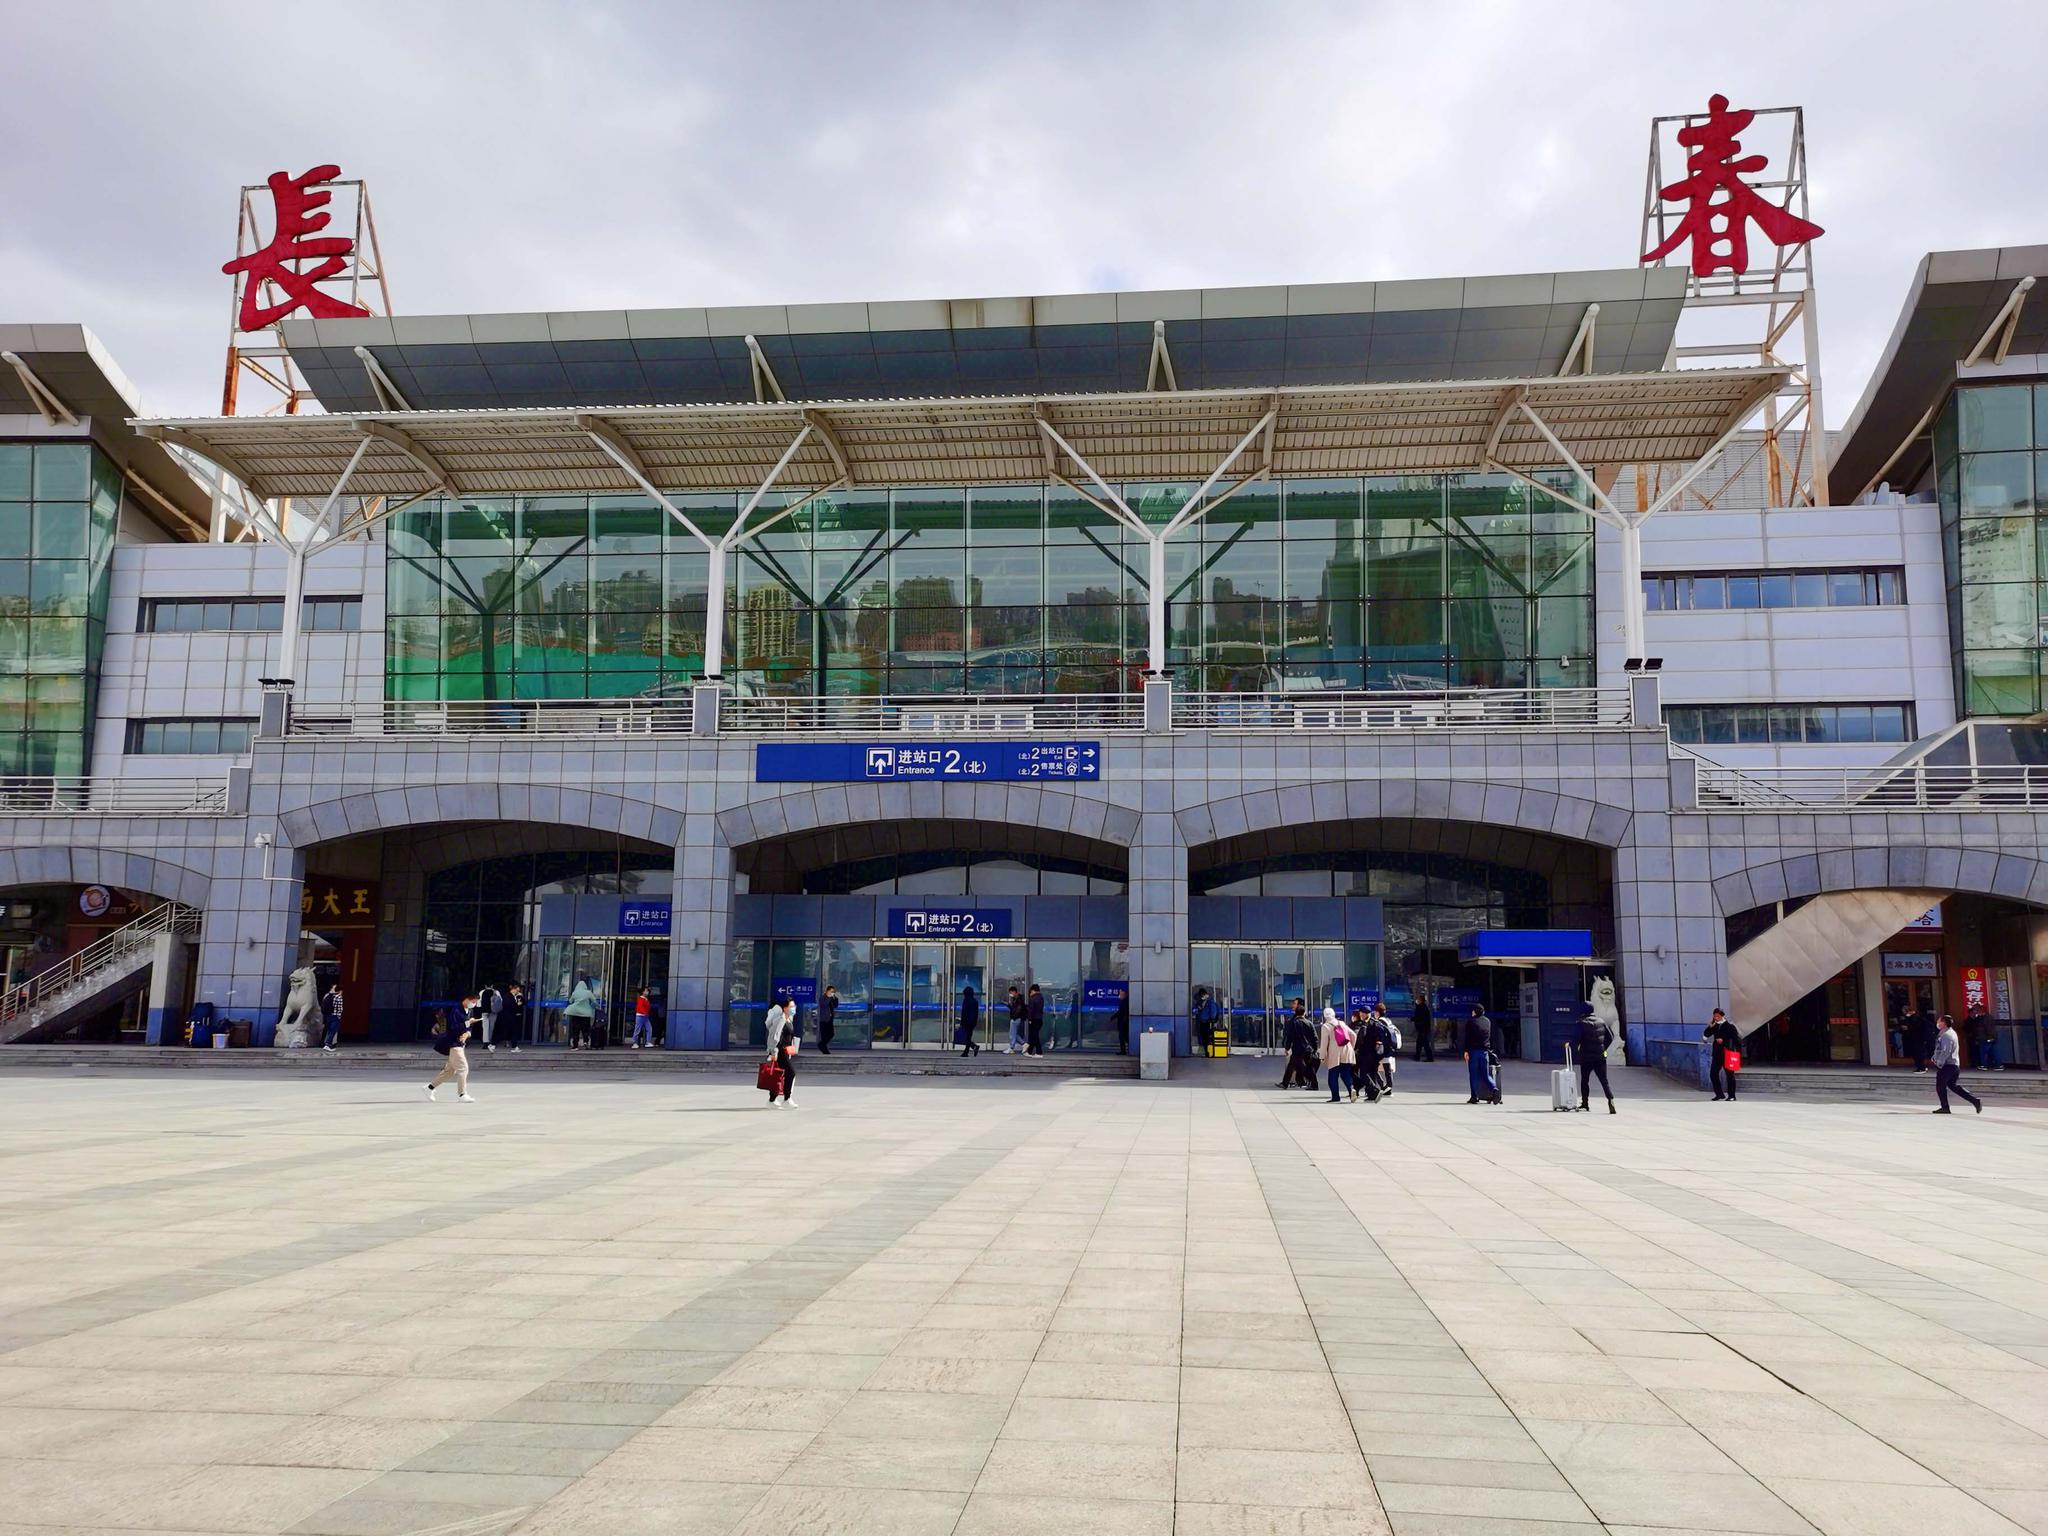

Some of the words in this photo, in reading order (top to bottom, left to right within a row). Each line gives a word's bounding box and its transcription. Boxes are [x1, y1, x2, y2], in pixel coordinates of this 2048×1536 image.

[1640, 94, 1825, 277] 春
[1031, 747, 1040, 760] 2
[1041, 747, 1063, 755] 出站口
[898, 750, 941, 764] 进站口
[944, 750, 961, 773] 2
[898, 766, 935, 775] Entrance
[1031, 763, 1040, 776] 2
[641, 910, 668, 919] 进站口
[928, 914, 960, 925] 进站口
[962, 914, 975, 932] 2
[928, 925, 956, 933] Entrance
